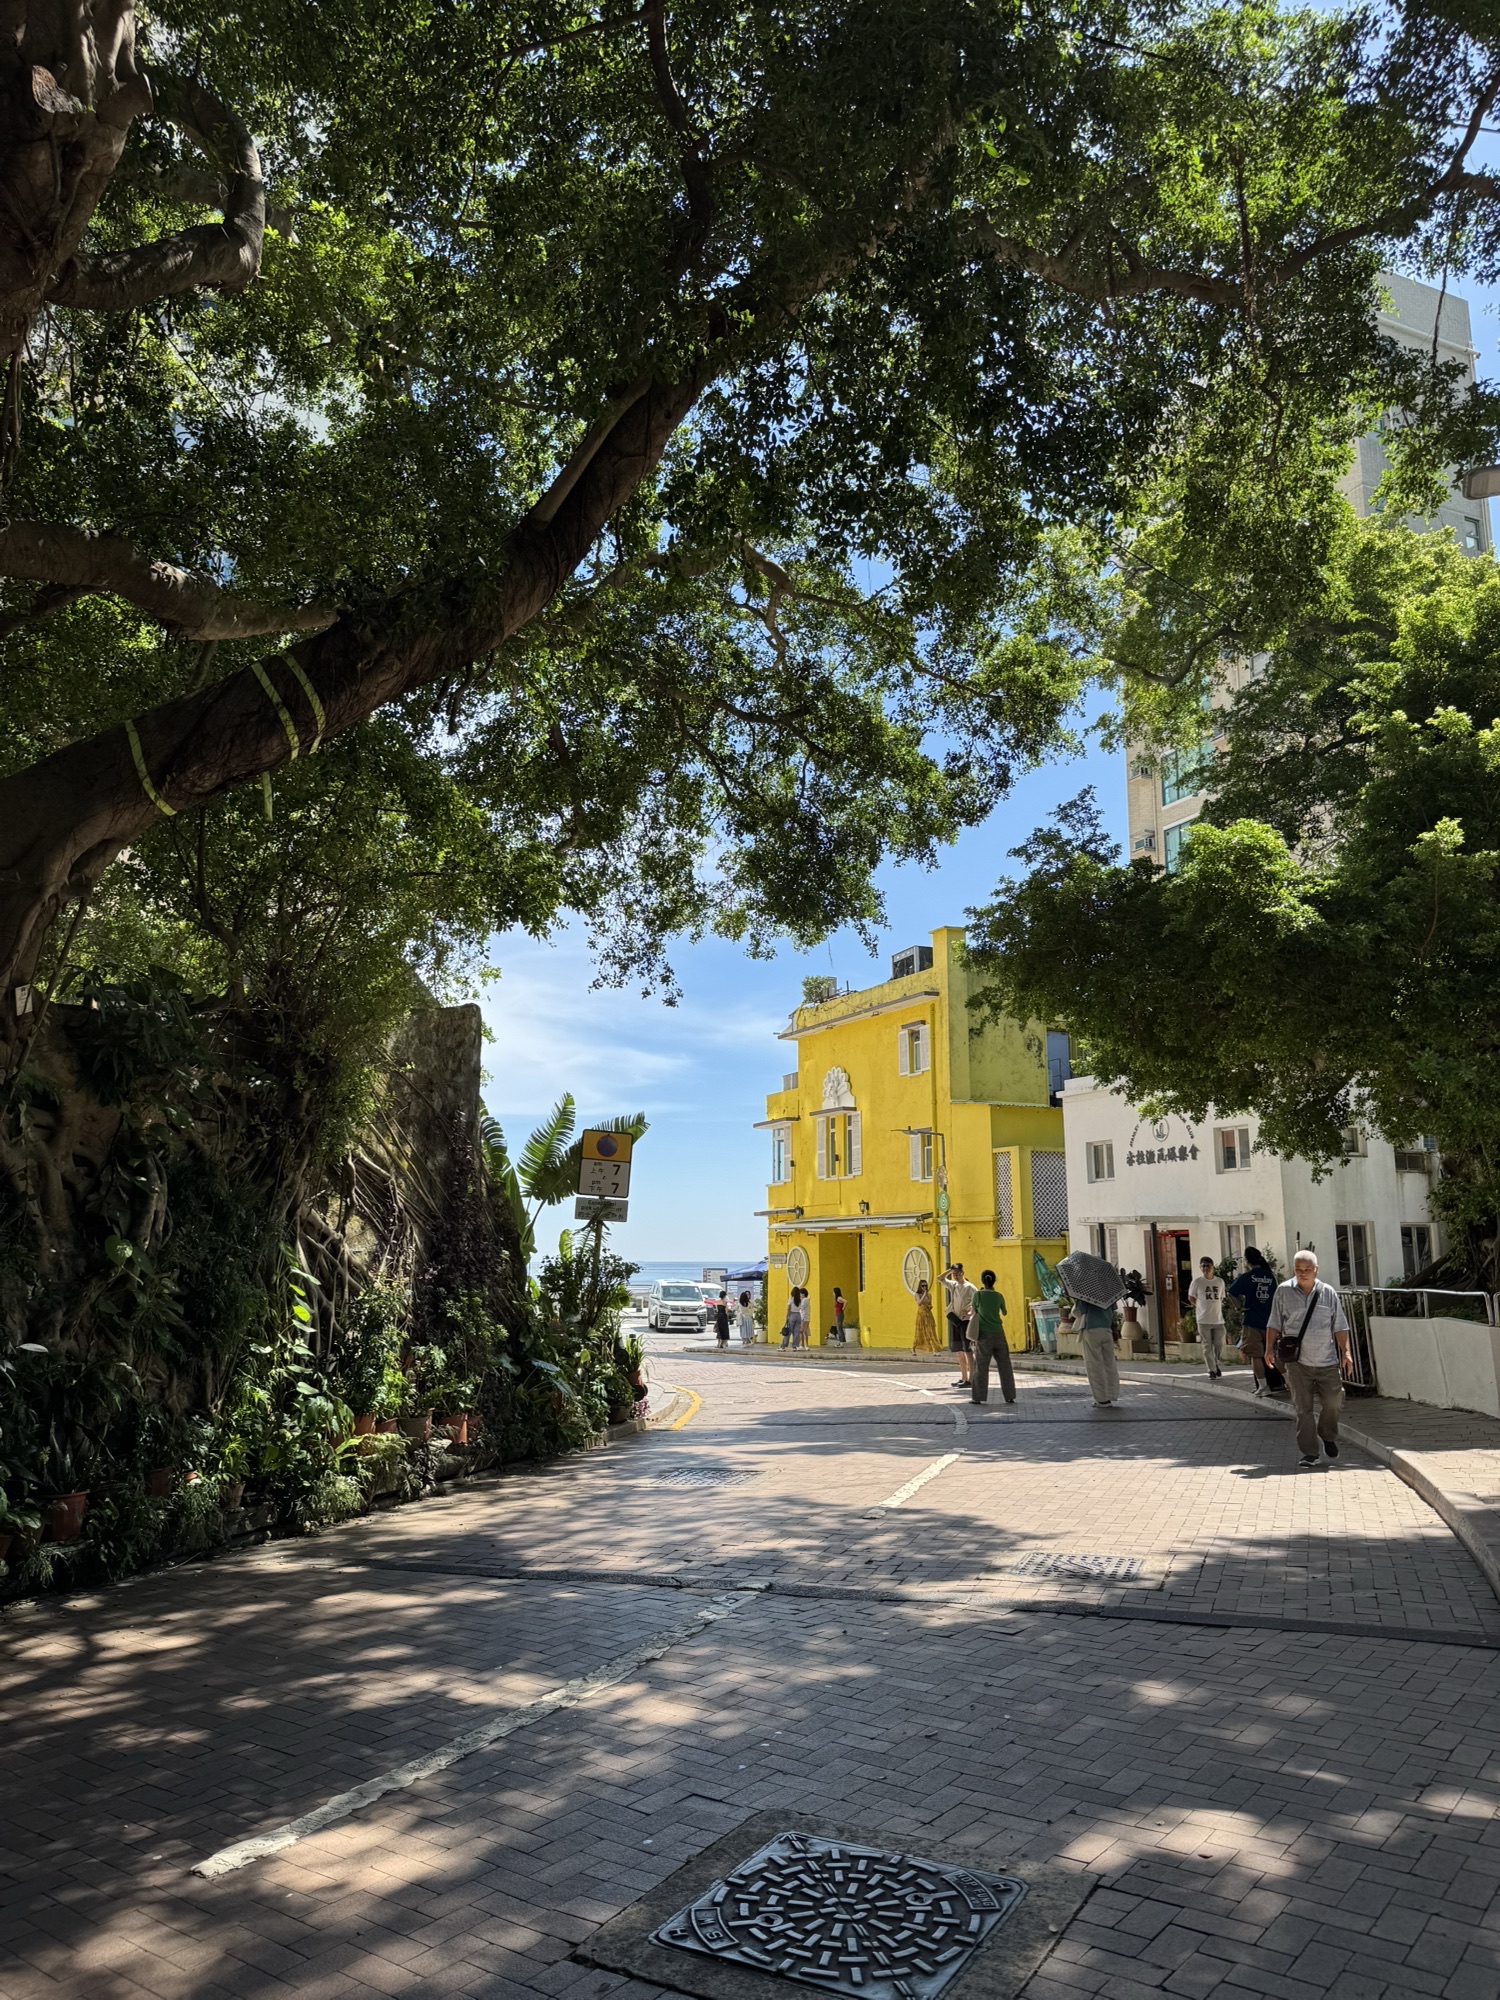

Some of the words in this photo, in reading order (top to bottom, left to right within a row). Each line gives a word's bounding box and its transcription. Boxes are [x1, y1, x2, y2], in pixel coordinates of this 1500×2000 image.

[612, 1164, 621, 1176] 7
[611, 1182, 620, 1194] 7
[972, 1888, 995, 1907] FUNG
